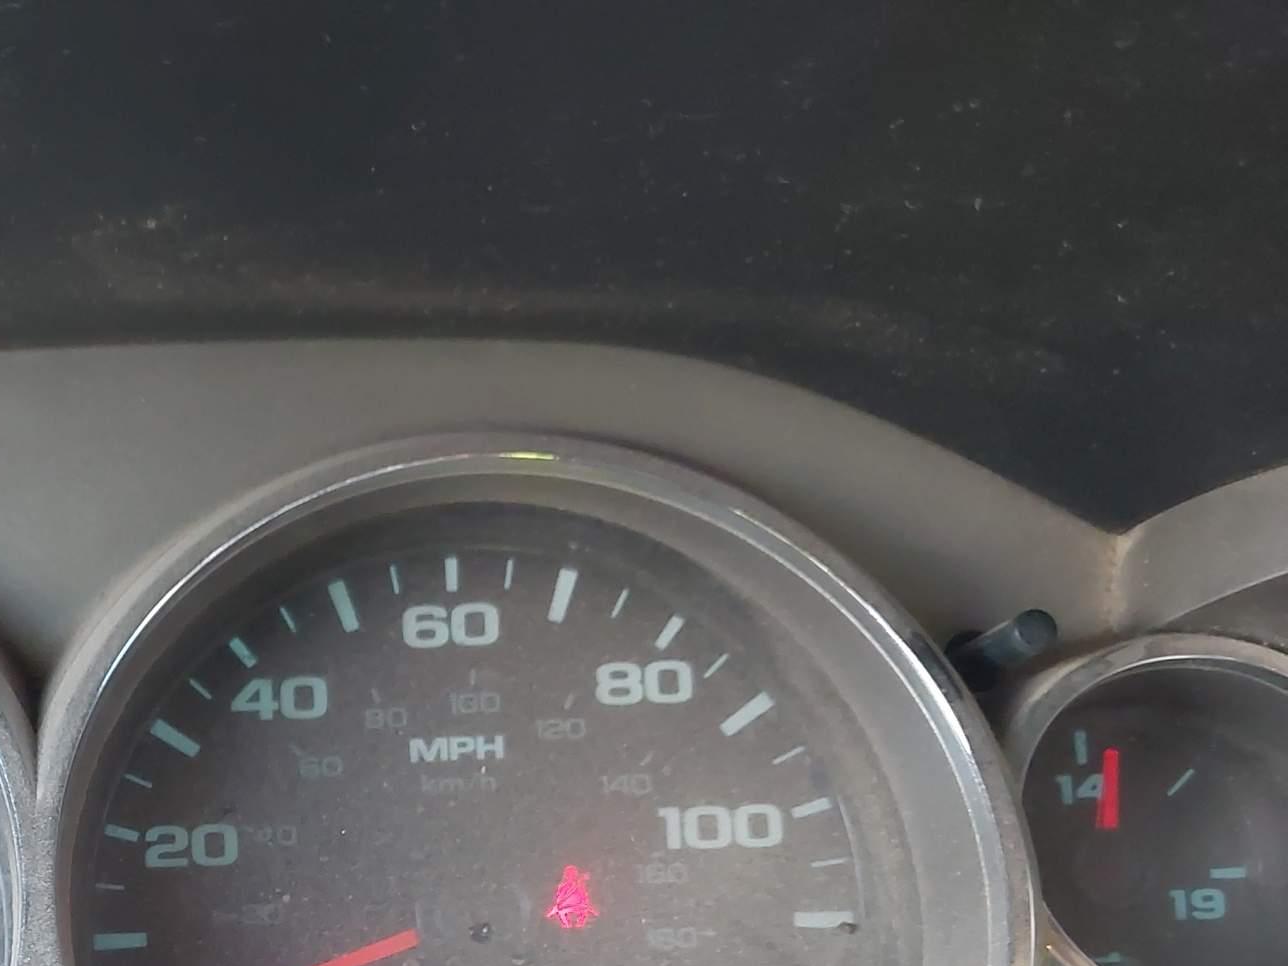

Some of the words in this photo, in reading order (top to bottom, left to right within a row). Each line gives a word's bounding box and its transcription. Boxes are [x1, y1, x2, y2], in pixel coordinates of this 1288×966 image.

[401, 602, 499, 648] 60
[230, 676, 328, 720] 40
[596, 659, 693, 706] 80
[409, 735, 505, 763] MPH
[535, 717, 587, 740] 120
[145, 823, 239, 868] 20
[658, 803, 783, 850] 100
[1169, 887, 1226, 921] 19
